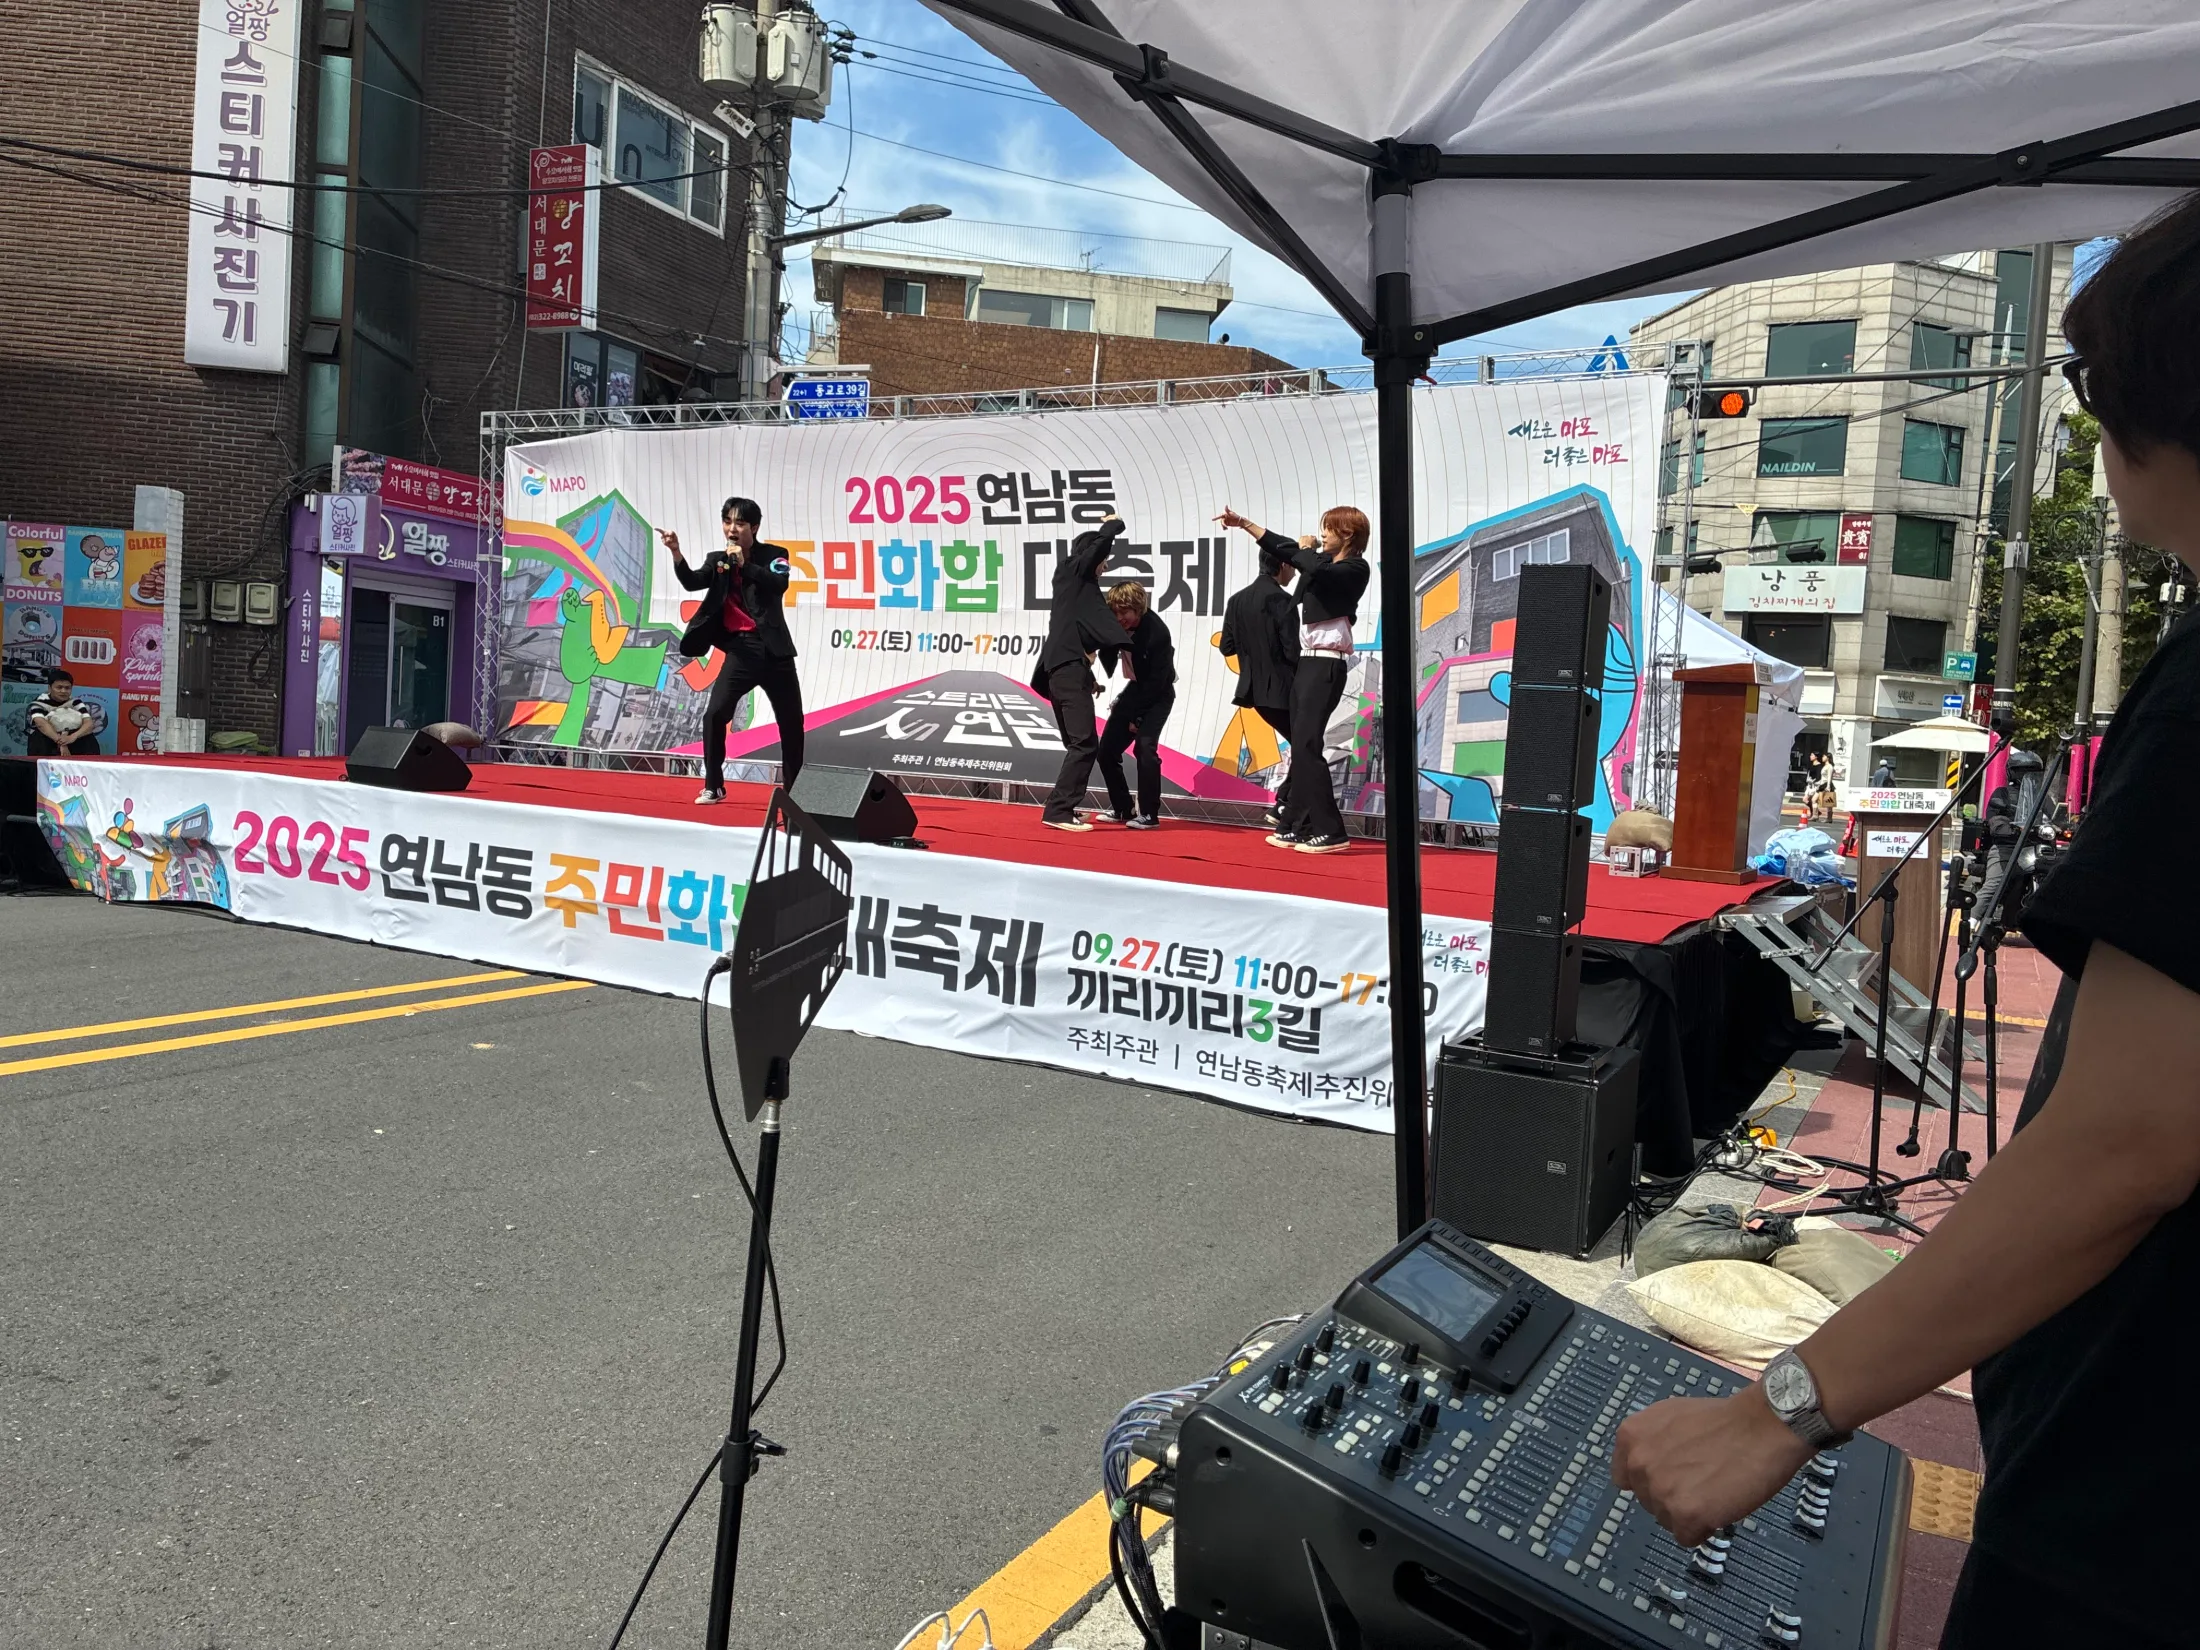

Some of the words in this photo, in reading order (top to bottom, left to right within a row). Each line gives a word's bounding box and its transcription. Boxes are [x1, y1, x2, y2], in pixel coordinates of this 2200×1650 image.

[226, 11, 271, 42] 얼짱
[212, 41, 267, 346] 스티커사진기
[533, 194, 547, 257] 서대문
[552, 200, 583, 304] 양꼬치
[815, 383, 866, 397] 동교로39길
[1508, 419, 1557, 440] 새로운
[1561, 417, 1598, 439] 마포
[1543, 446, 1560, 468] 더
[1562, 446, 1590, 467] 좋은
[1593, 444, 1628, 466] 마포
[1760, 462, 1816, 473] NAILDIN
[388, 476, 424, 497] 서대문
[549, 475, 586, 493] MAPO
[443, 485, 488, 511] 양꼬치
[845, 475, 971, 525] 2025
[976, 469, 1116, 526] 연남동
[8, 525, 64, 541] Colorful
[332, 525, 354, 543] 얼짱
[402, 521, 450, 566] 얼짱
[329, 543, 356, 552] 스티커사진
[764, 538, 1003, 615] 주민화합
[6, 588, 62, 602] DONUTS
[1822, 597, 1836, 610] 집
[300, 589, 312, 663] 스티커사진
[433, 615, 445, 627] B1
[830, 629, 912, 652] 09.27.(토)
[917, 632, 1022, 655] 11:00-17:00
[122, 657, 157, 674] Pink
[1947, 657, 1958, 669] P
[893, 690, 1041, 711] 스트리트
[943, 710, 1069, 752] 연남
[892, 754, 924, 766] 주최주관
[934, 756, 1012, 773] 연남동축제추진위원회
[1859, 799, 1901, 810] 주민화합
[1903, 800, 1936, 811] 대축제
[1871, 791, 1896, 799] 2025
[1897, 791, 1924, 800] 연남동
[232, 810, 371, 892] 2025
[380, 833, 534, 920] 연남동
[1450, 934, 1482, 951] 마포
[1071, 930, 1224, 985] 09.27.(토)
[1234, 955, 1439, 1017] 11:00-17:0
[1433, 955, 1448, 973] 더
[1450, 956, 1473, 974] 좋은
[1067, 967, 1322, 1055] 끼리끼리3길
[1067, 1026, 1160, 1065] 주최주관
[1195, 1048, 1434, 1109] 연남동축제추진위
